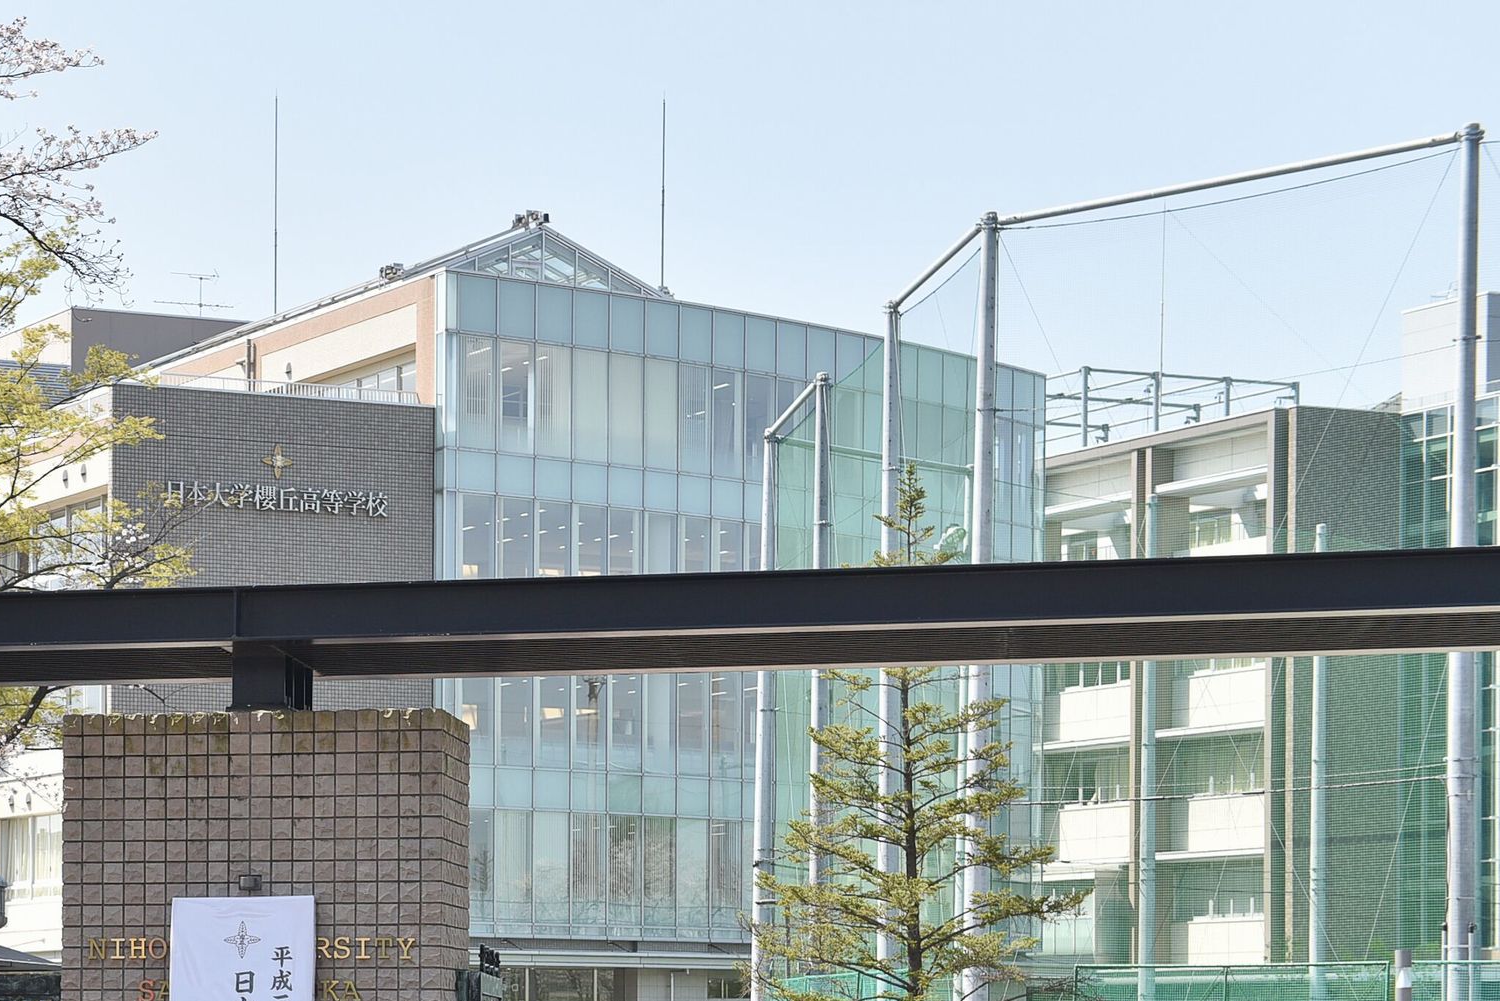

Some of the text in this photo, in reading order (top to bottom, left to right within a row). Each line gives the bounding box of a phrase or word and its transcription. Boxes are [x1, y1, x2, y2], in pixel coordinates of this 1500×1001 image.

[167, 480, 388, 518] 日本大学櫻丘高等学校
[88, 936, 416, 960] NIHO RSITY
